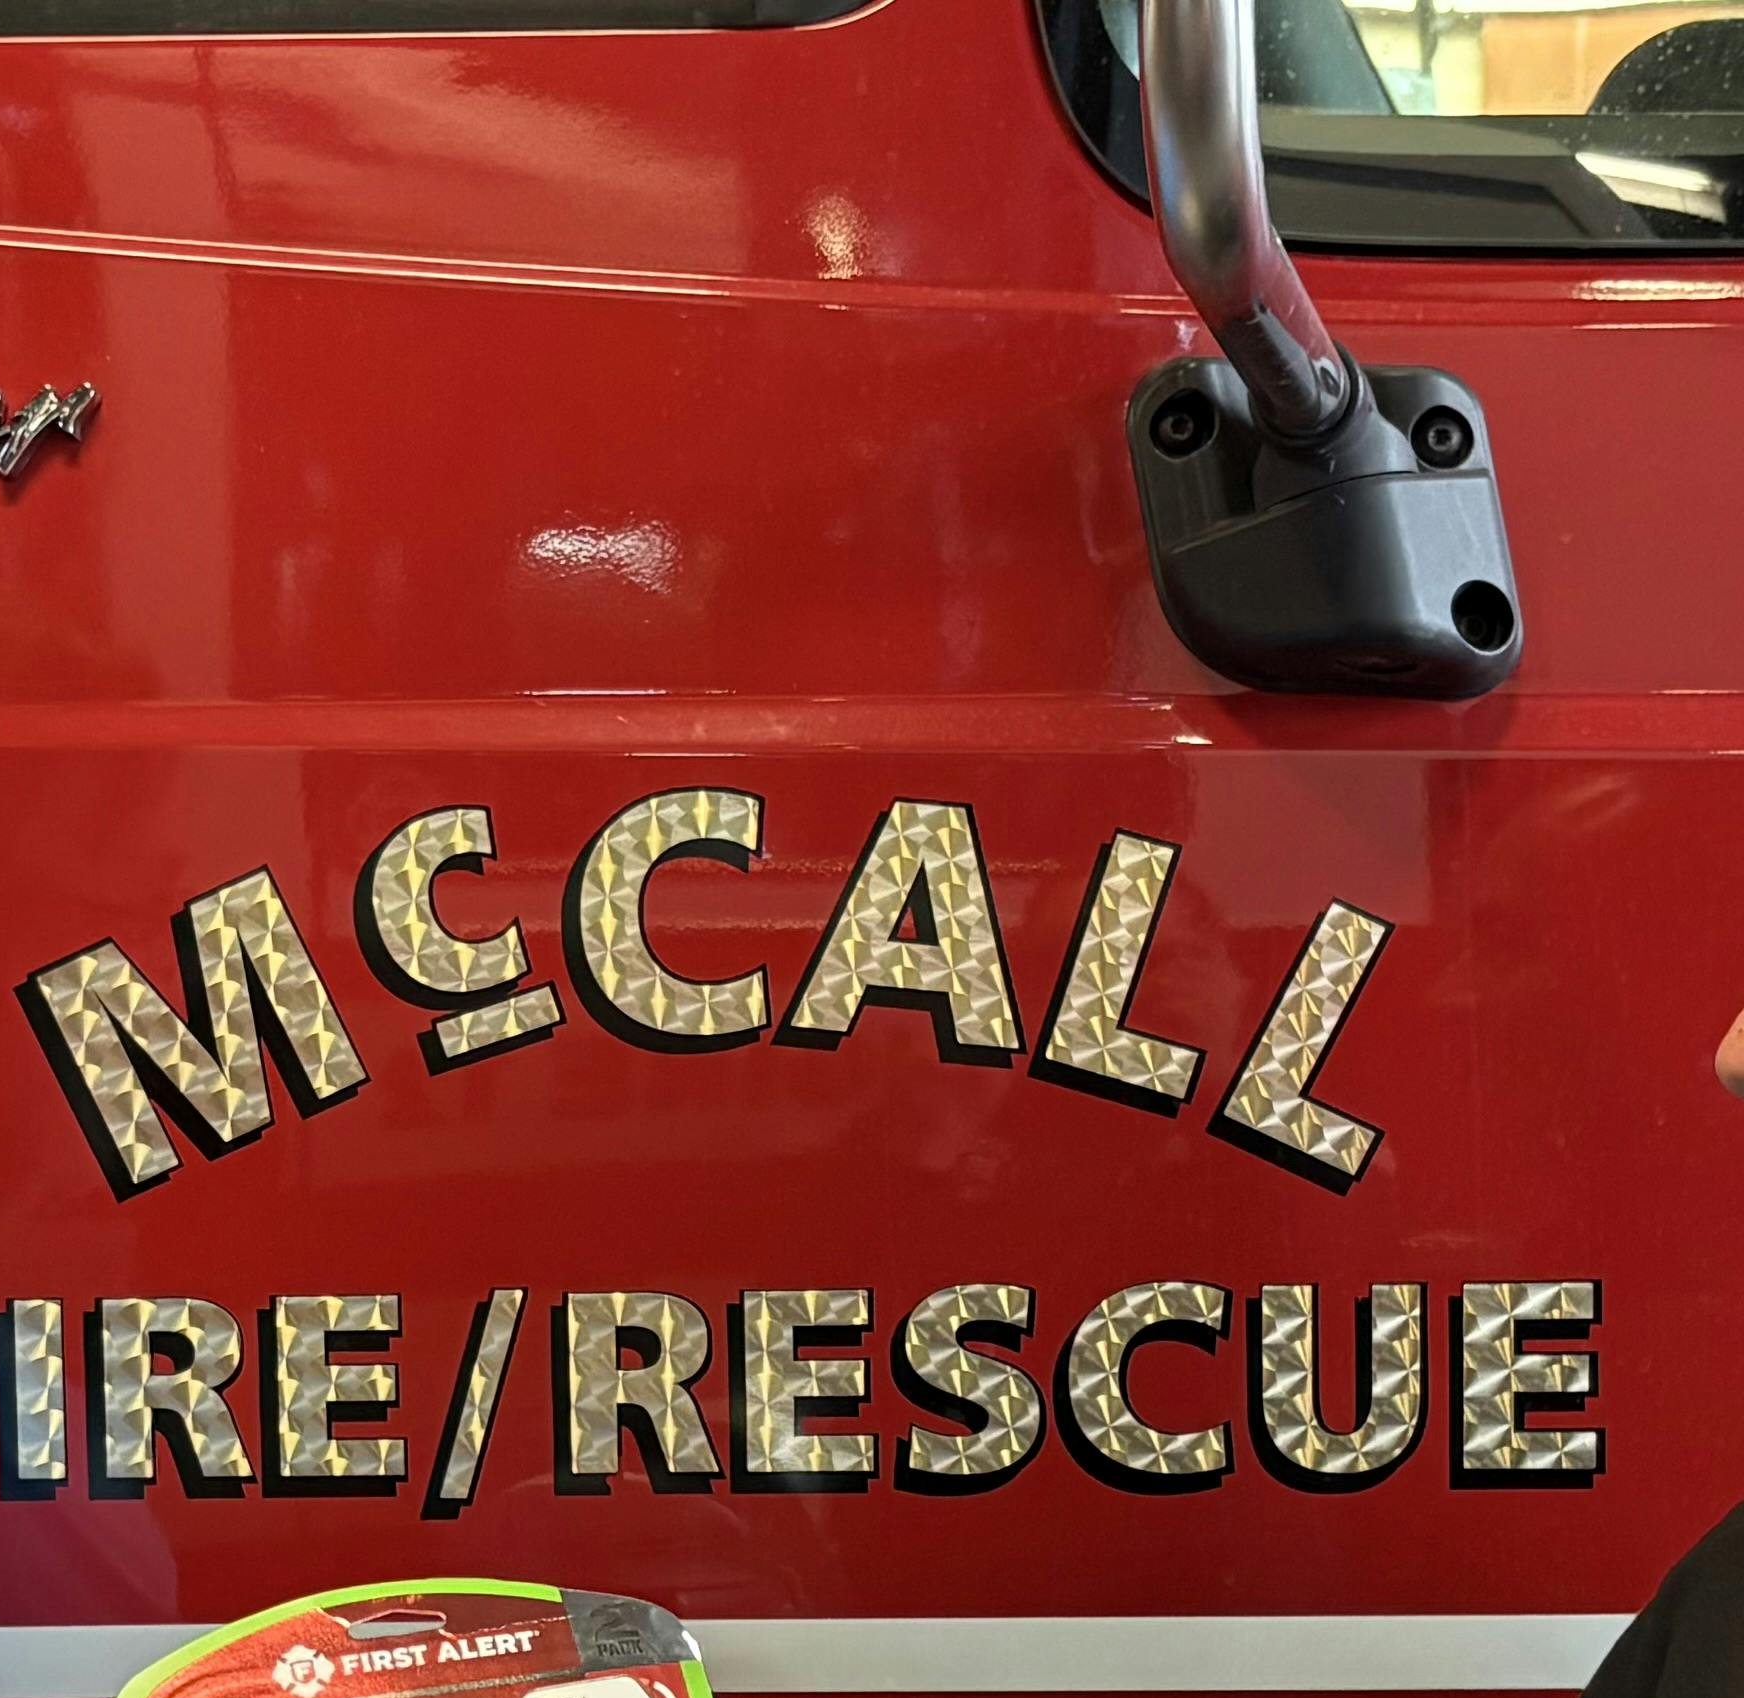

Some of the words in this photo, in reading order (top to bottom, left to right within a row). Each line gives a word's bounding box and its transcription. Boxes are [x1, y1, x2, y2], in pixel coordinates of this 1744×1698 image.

[340, 1644, 428, 1676] FIRST
[437, 1630, 535, 1663] ALERT
[595, 1639, 644, 1657] PACK
